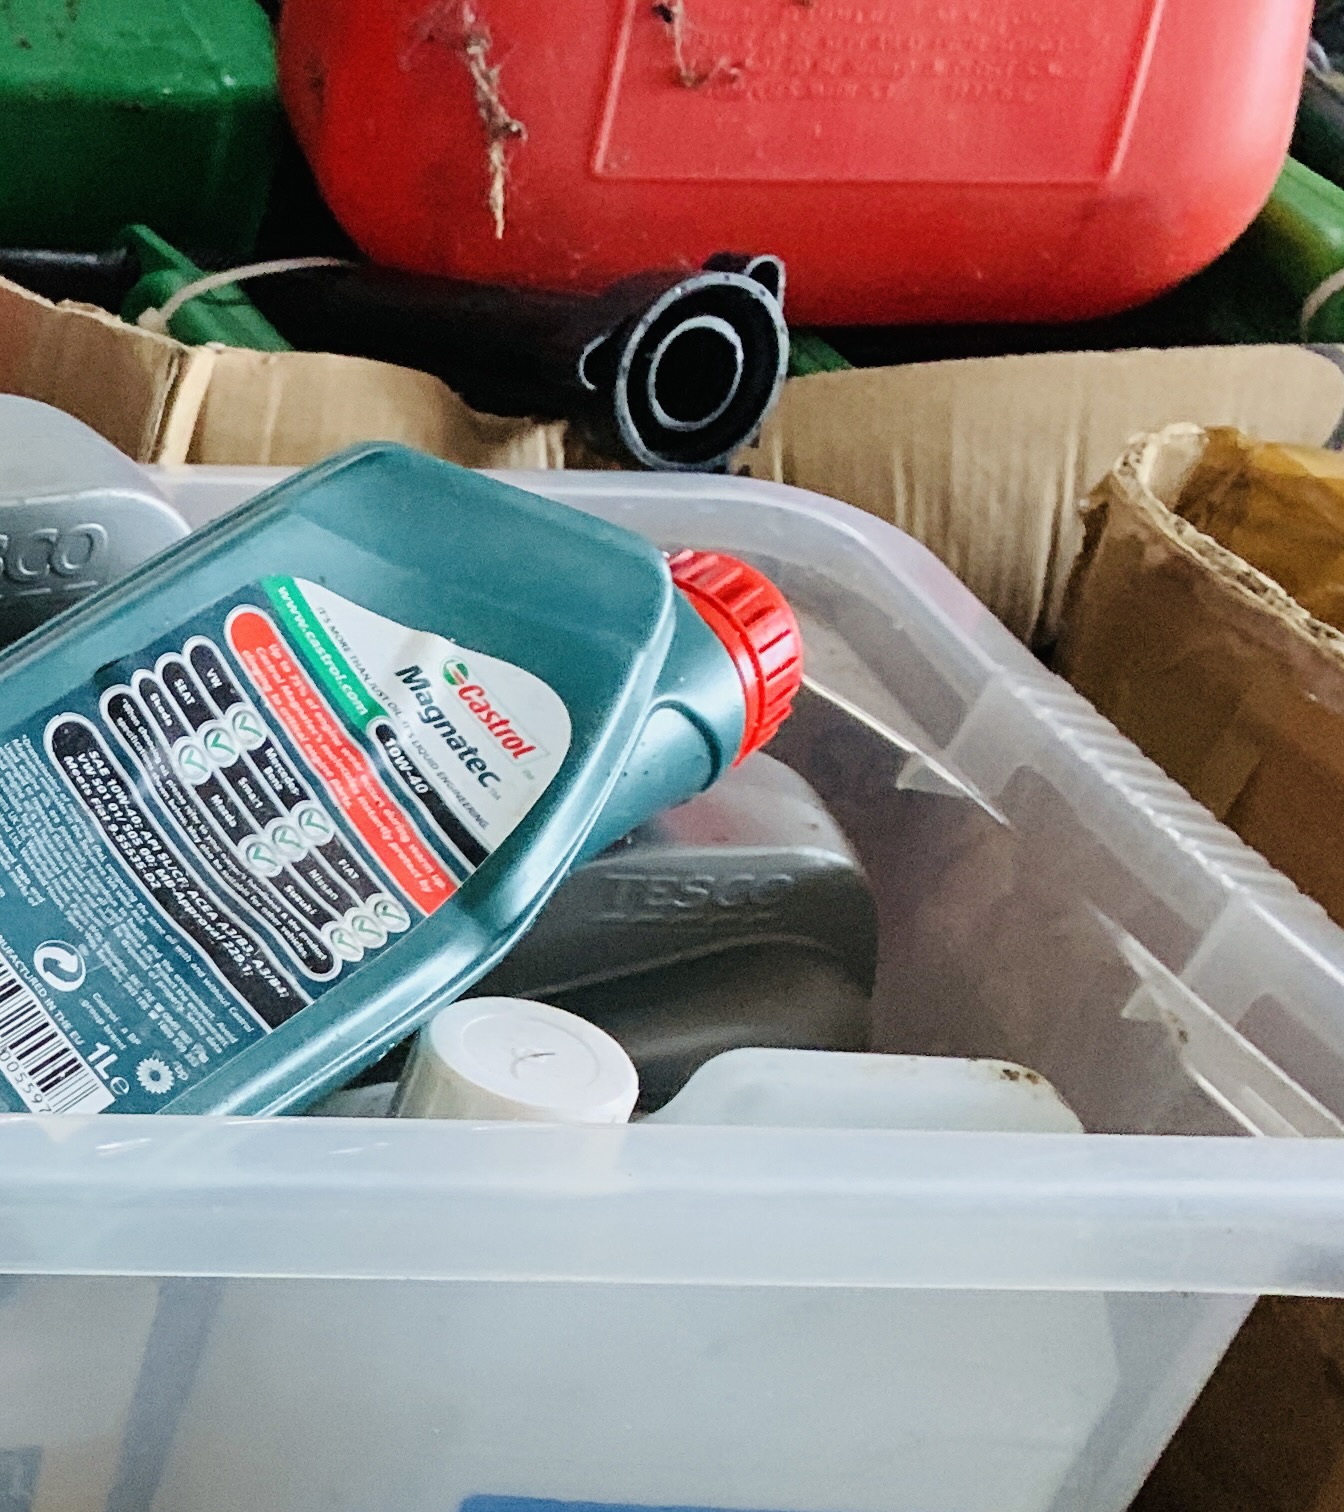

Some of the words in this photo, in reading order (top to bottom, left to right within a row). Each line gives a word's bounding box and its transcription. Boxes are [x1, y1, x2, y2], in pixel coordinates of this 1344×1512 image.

[276, 585, 369, 716] www.castrol.com
[172, 676, 197, 707] SEAT
[203, 667, 223, 690] VW
[327, 623, 351, 652] MORE
[349, 653, 371, 681] THAN
[368, 678, 389, 702] JUST
[411, 737, 440, 771] LIQUID
[147, 690, 176, 727] Skoda
[390, 659, 504, 795] Magnatec
[456, 679, 536, 762] Castrol
[261, 764, 285, 792] Benz
[382, 736, 430, 797] 10W-40
[61, 753, 95, 797] Meets
[88, 795, 113, 823] Fiat
[75, 752, 97, 779] VW
[90, 774, 112, 801] 501
[121, 821, 144, 847] 505
[236, 775, 264, 809] Smart
[209, 792, 239, 829] Mazda
[87, 748, 111, 778] SAE
[105, 777, 146, 831] 10W-40;
[139, 827, 161, 852] API
[186, 887, 219, 921] ACEA
[307, 868, 339, 902] Nissan
[337, 857, 360, 882] FIAT
[282, 882, 318, 917] Suzuki
[602, 872, 794, 914] TESCO
[43, 997, 57, 1011] IN
[54, 1010, 73, 1032] THE
[68, 1029, 85, 1047] EU
[102, 1023, 128, 1052] brand
